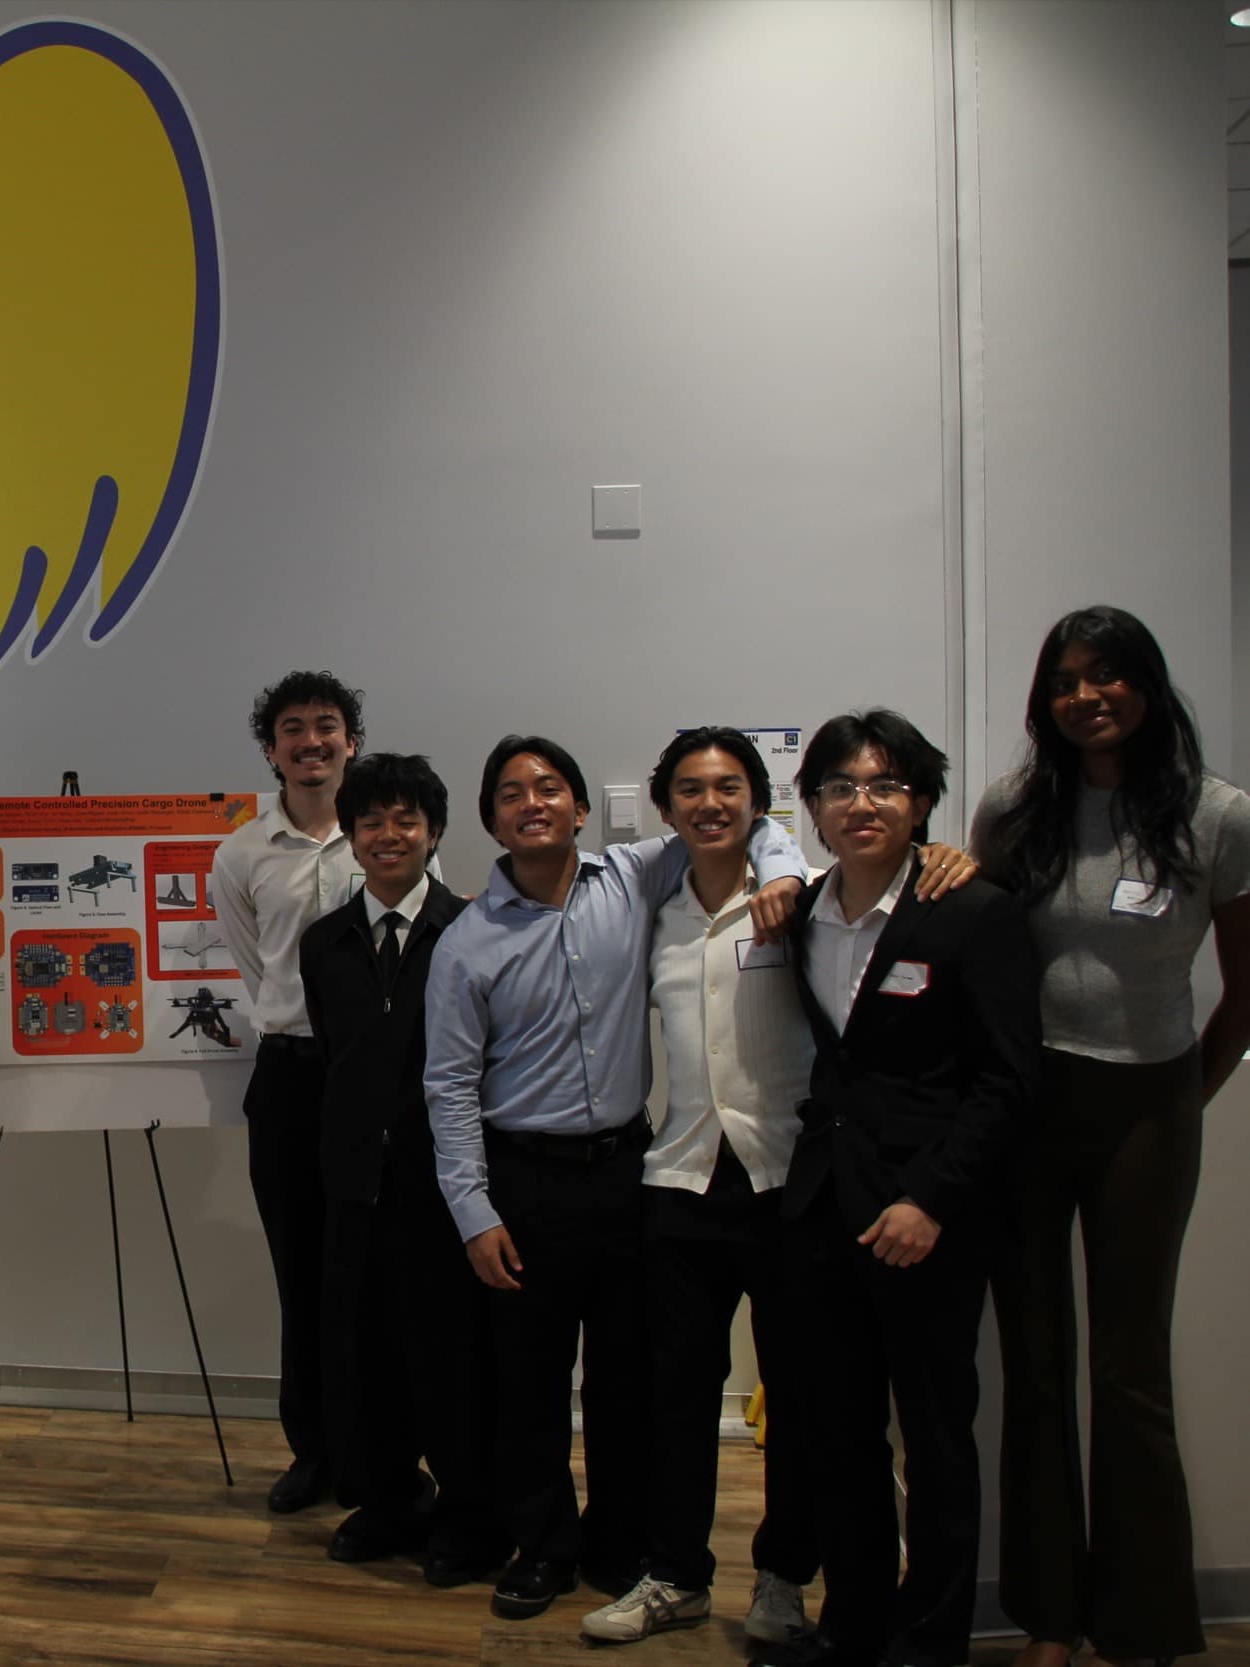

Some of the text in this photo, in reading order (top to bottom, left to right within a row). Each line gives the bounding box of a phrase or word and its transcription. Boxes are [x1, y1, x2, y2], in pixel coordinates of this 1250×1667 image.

[33, 800, 88, 809] Controlled
[91, 799, 139, 808] Precision
[142, 798, 173, 810] Cargo
[176, 798, 207, 808] Drone
